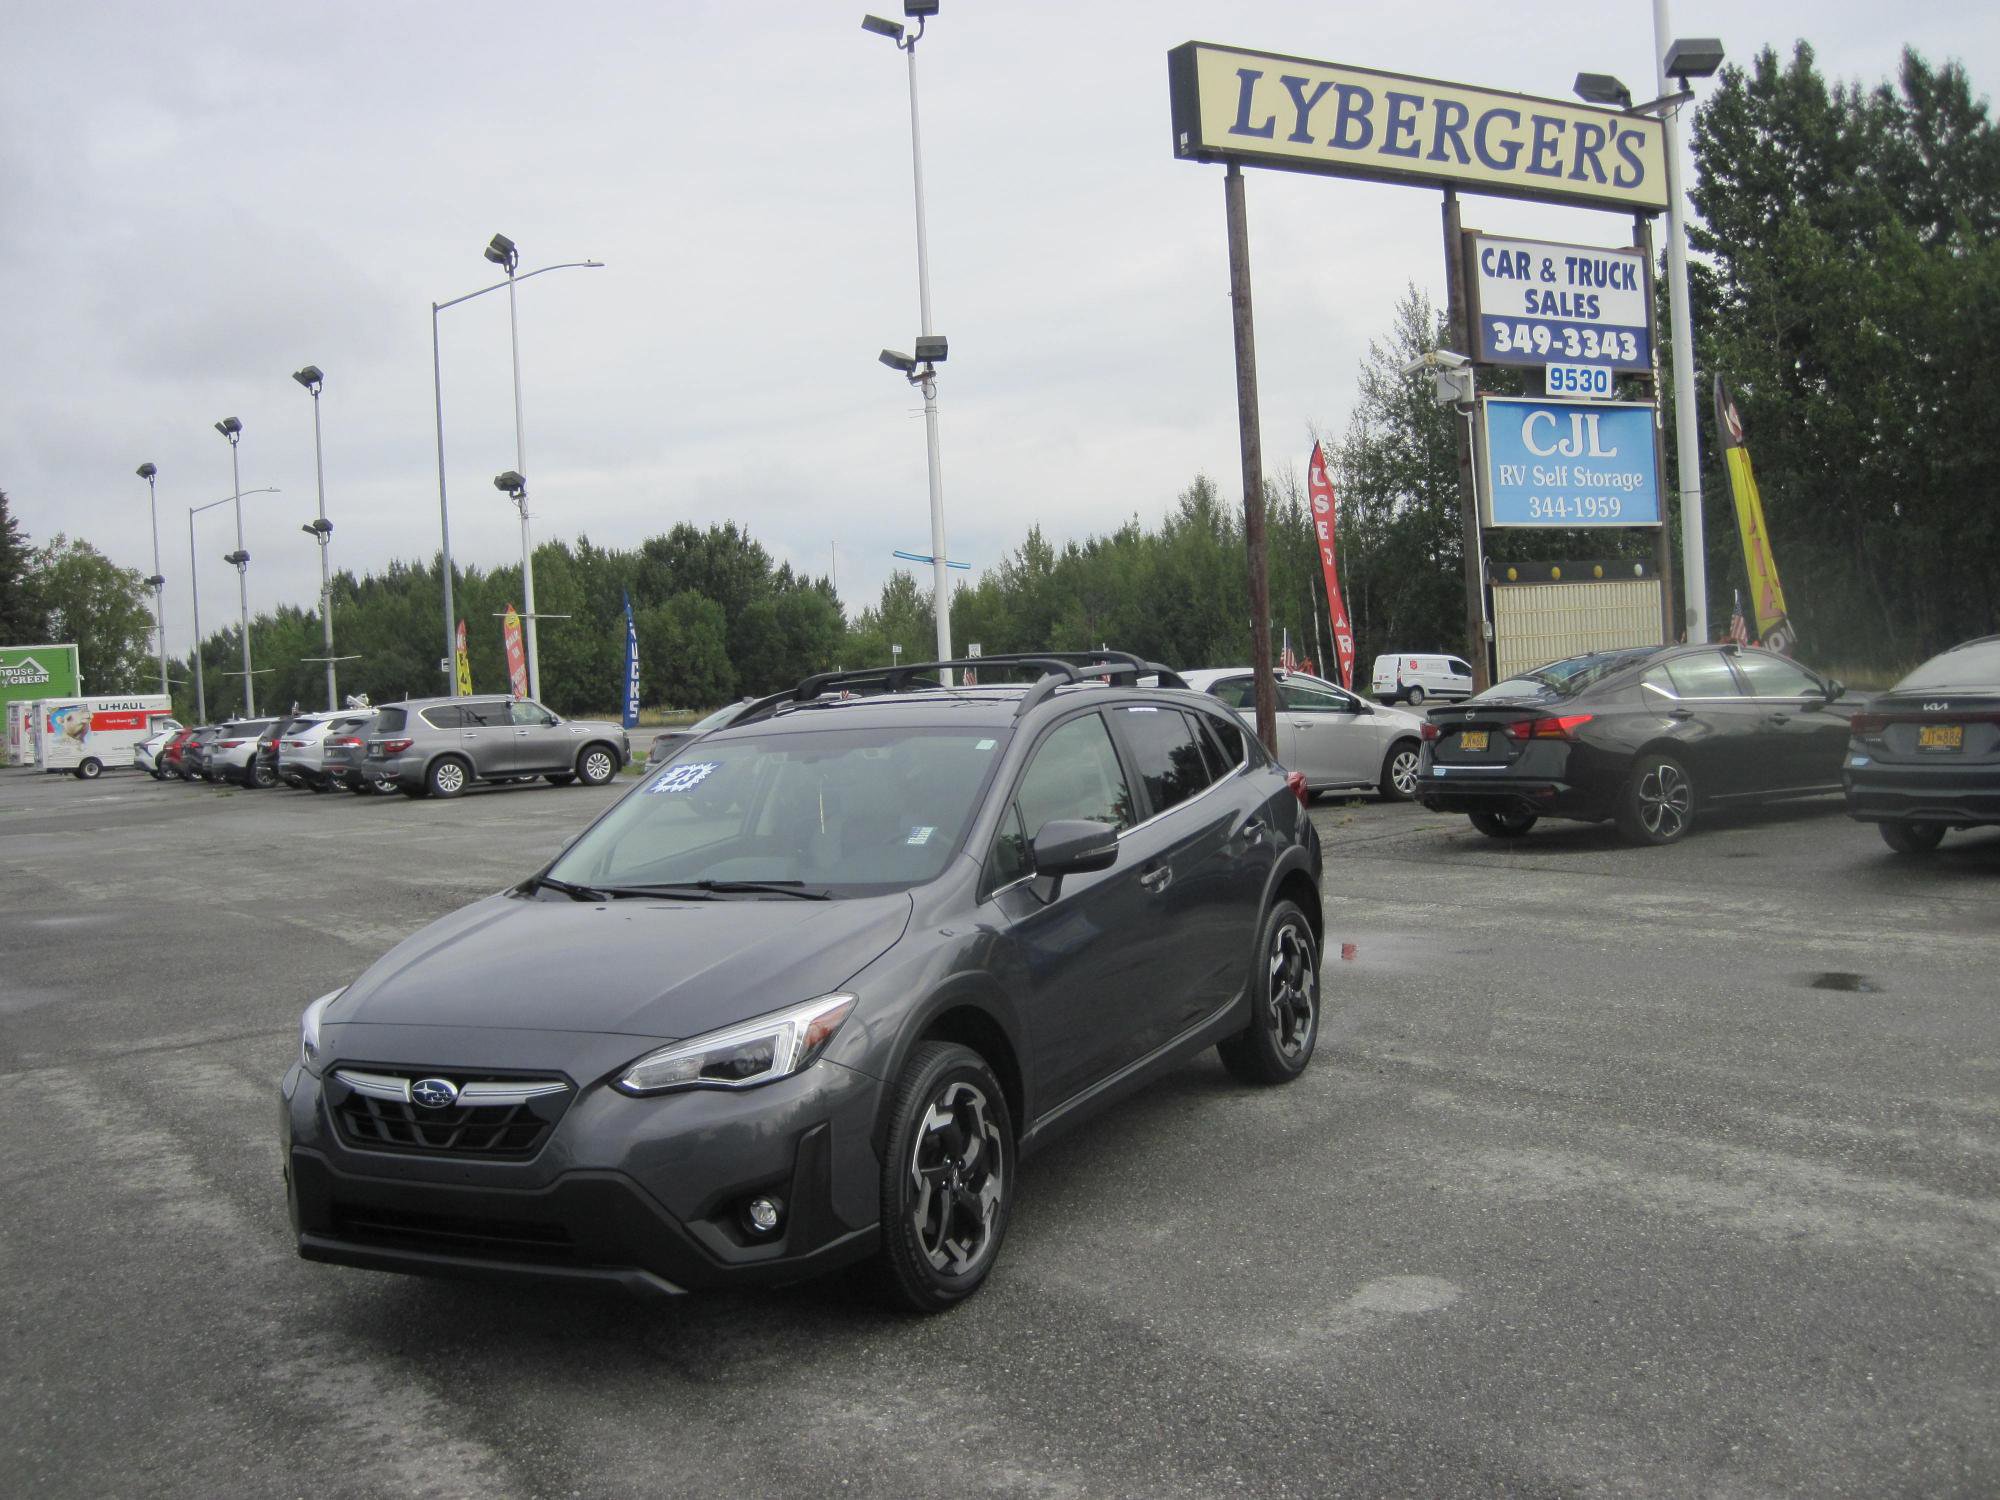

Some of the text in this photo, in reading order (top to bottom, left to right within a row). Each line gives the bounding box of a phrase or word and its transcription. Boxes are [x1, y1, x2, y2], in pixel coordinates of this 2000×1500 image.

[1228, 68, 1646, 189] LYBERGER'S
[1481, 247, 1637, 291] CAR & TRUCK
[1525, 288, 1600, 320] SALES
[1492, 322, 1638, 361] 349-3343
[1550, 367, 1607, 393] 9530
[1521, 410, 1617, 457] CJL
[1500, 465, 1643, 492] RV Self Storage
[1529, 496, 1621, 518] 344-1959
[10, 674, 49, 684] GREEN
[629, 612, 640, 718] UCKS
[98, 702, 146, 711] U-HAUL
